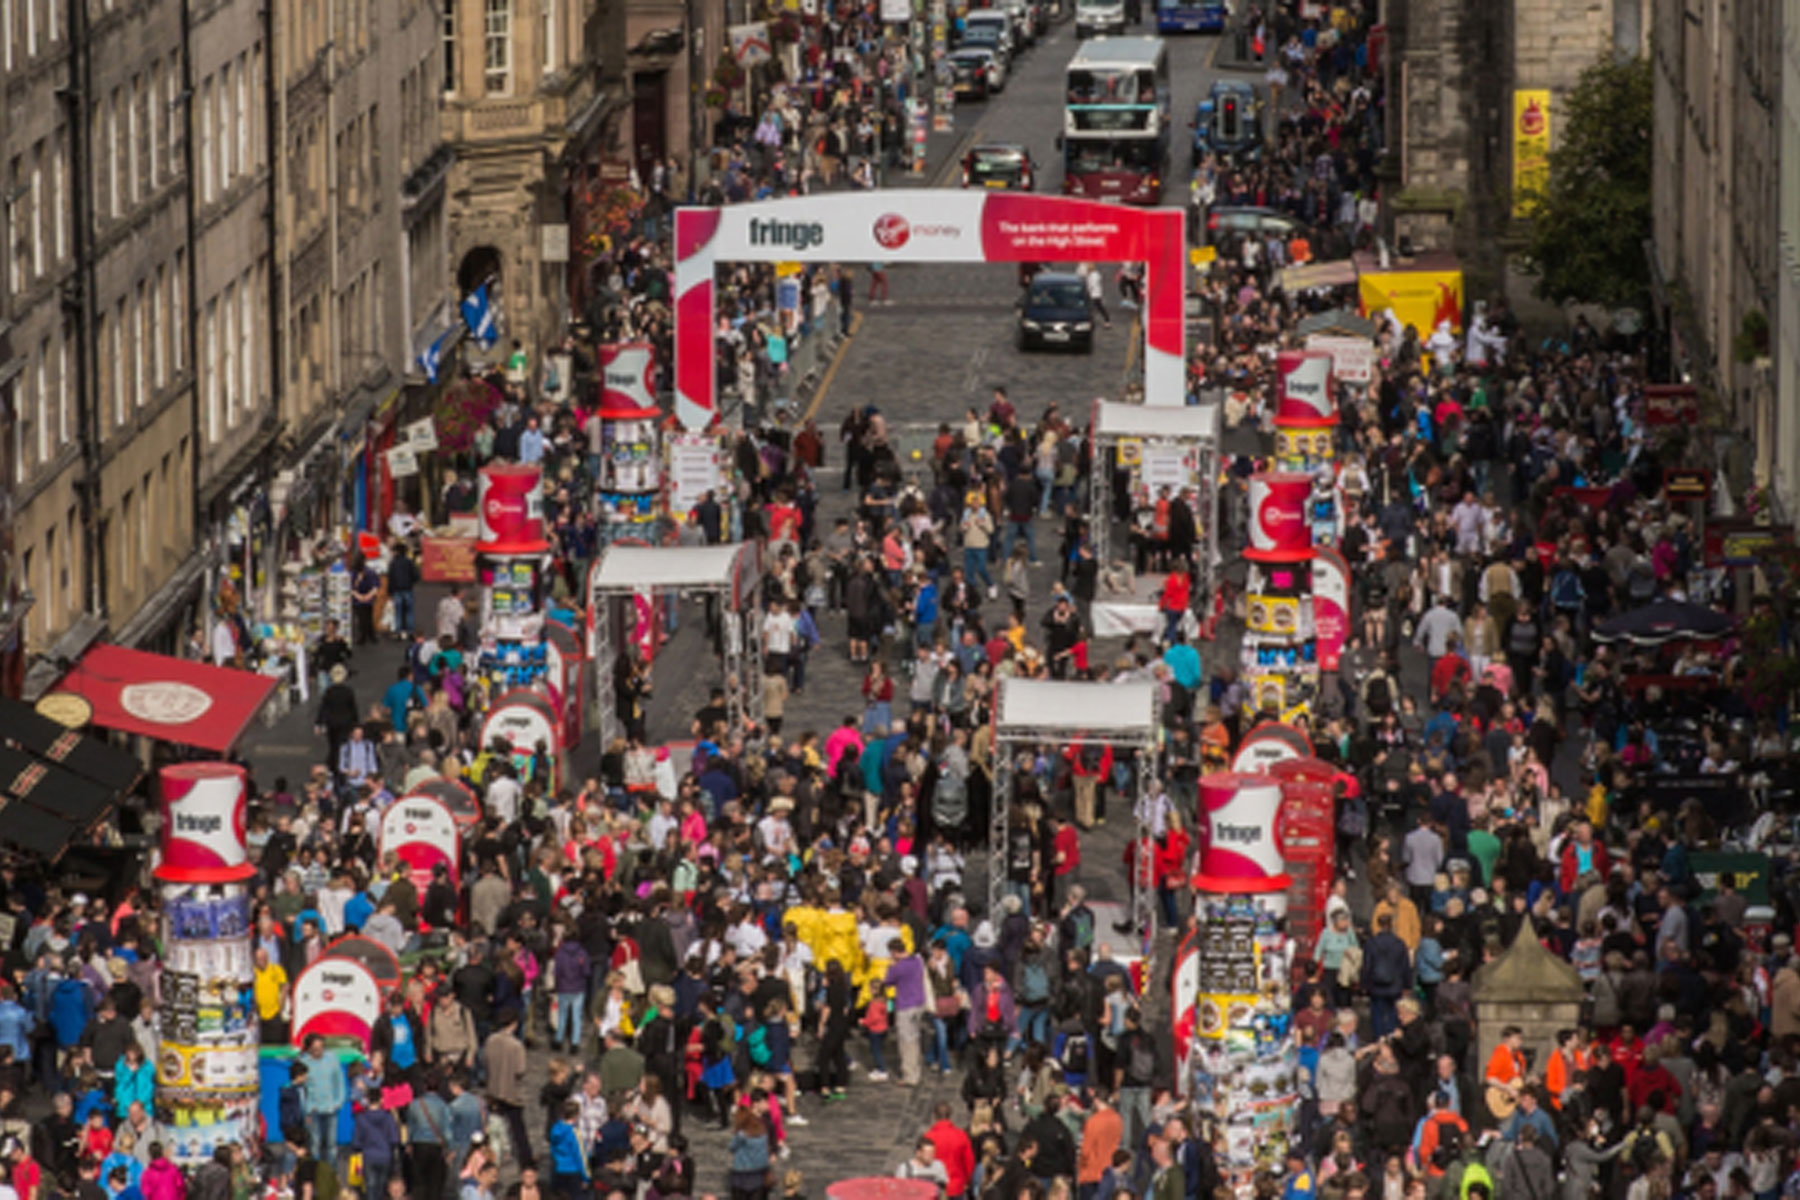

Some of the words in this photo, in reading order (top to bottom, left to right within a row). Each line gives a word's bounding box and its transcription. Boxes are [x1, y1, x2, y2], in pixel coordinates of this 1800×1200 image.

[749, 217, 824, 250] fringe
[912, 225, 961, 239] money
[999, 221, 1019, 232] The
[175, 812, 222, 834] fringe
[1215, 822, 1262, 845] fringe
